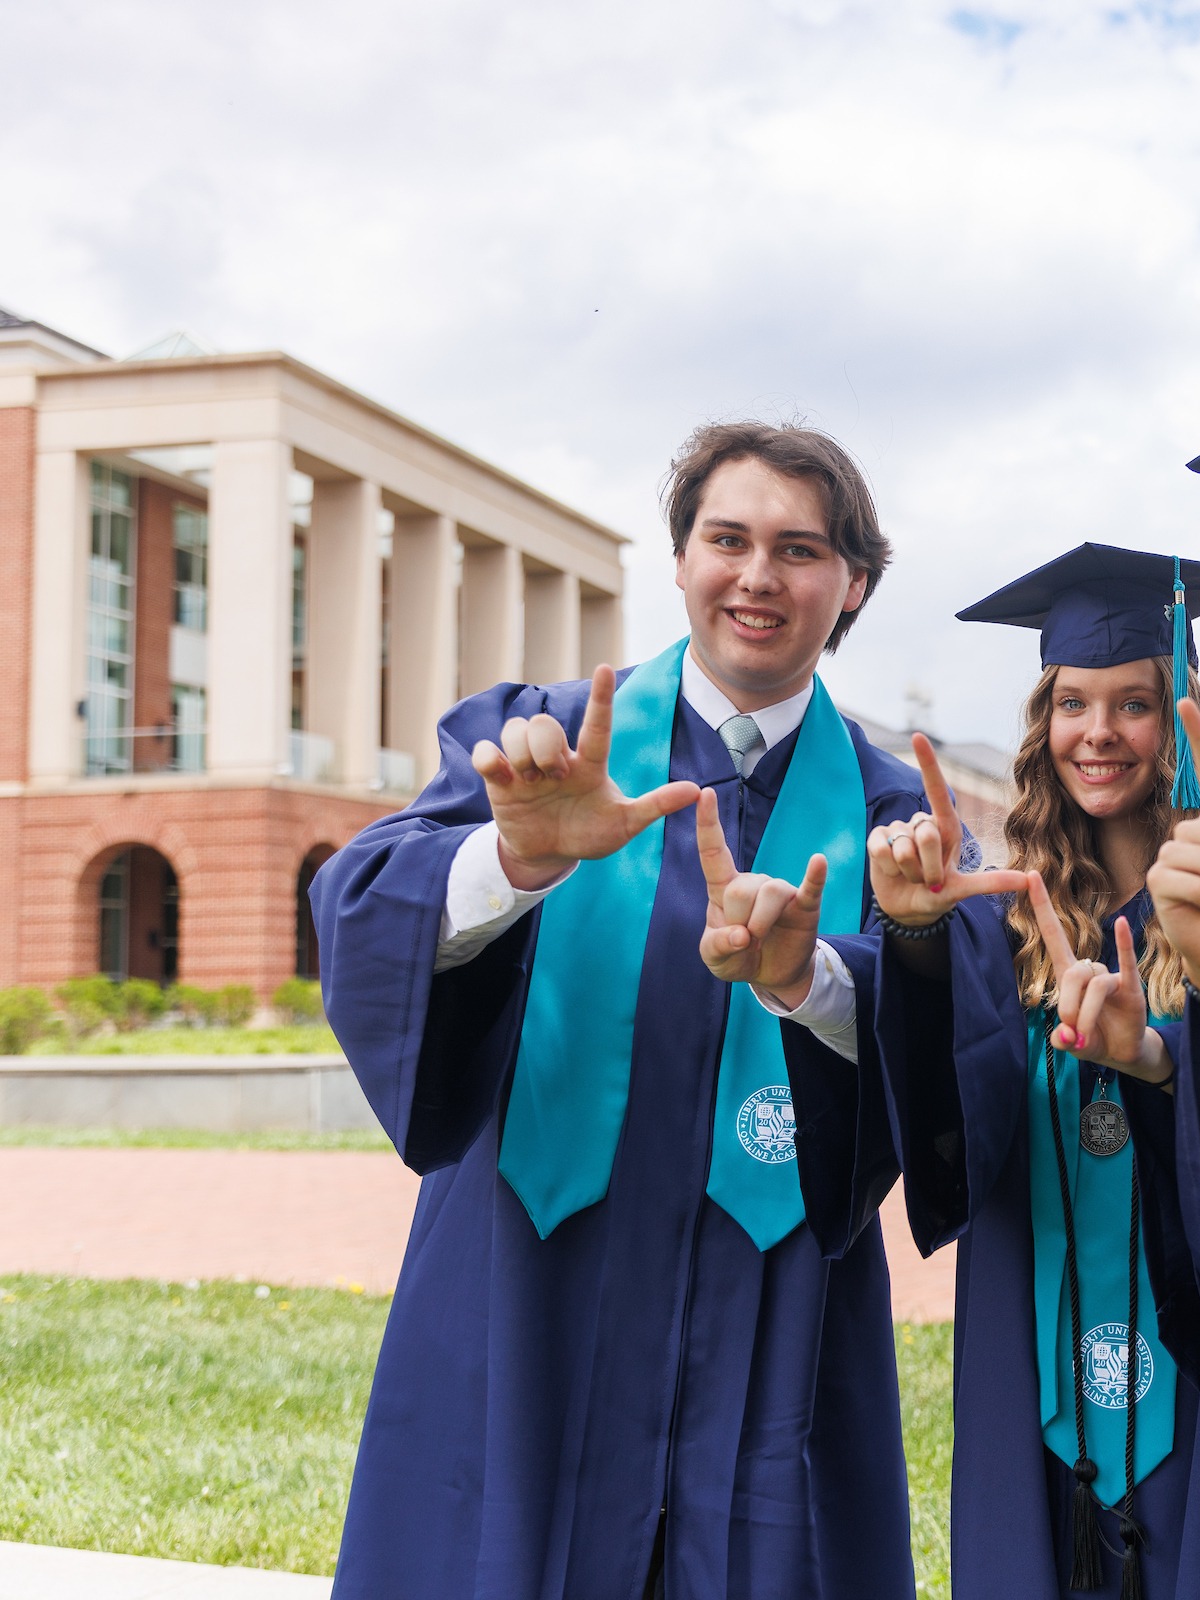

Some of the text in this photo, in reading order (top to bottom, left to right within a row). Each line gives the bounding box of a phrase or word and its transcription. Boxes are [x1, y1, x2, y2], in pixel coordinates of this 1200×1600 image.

[740, 1088, 792, 1121] LIBERTY UNI
[758, 1118, 794, 1128] 20 07
[740, 1131, 797, 1161] ONLINE ACAD
[1107, 1326, 1151, 1369] UNIRSITY
[1095, 1359, 1106, 1367] 20
[1110, 1377, 1149, 1406] ACAEMY
